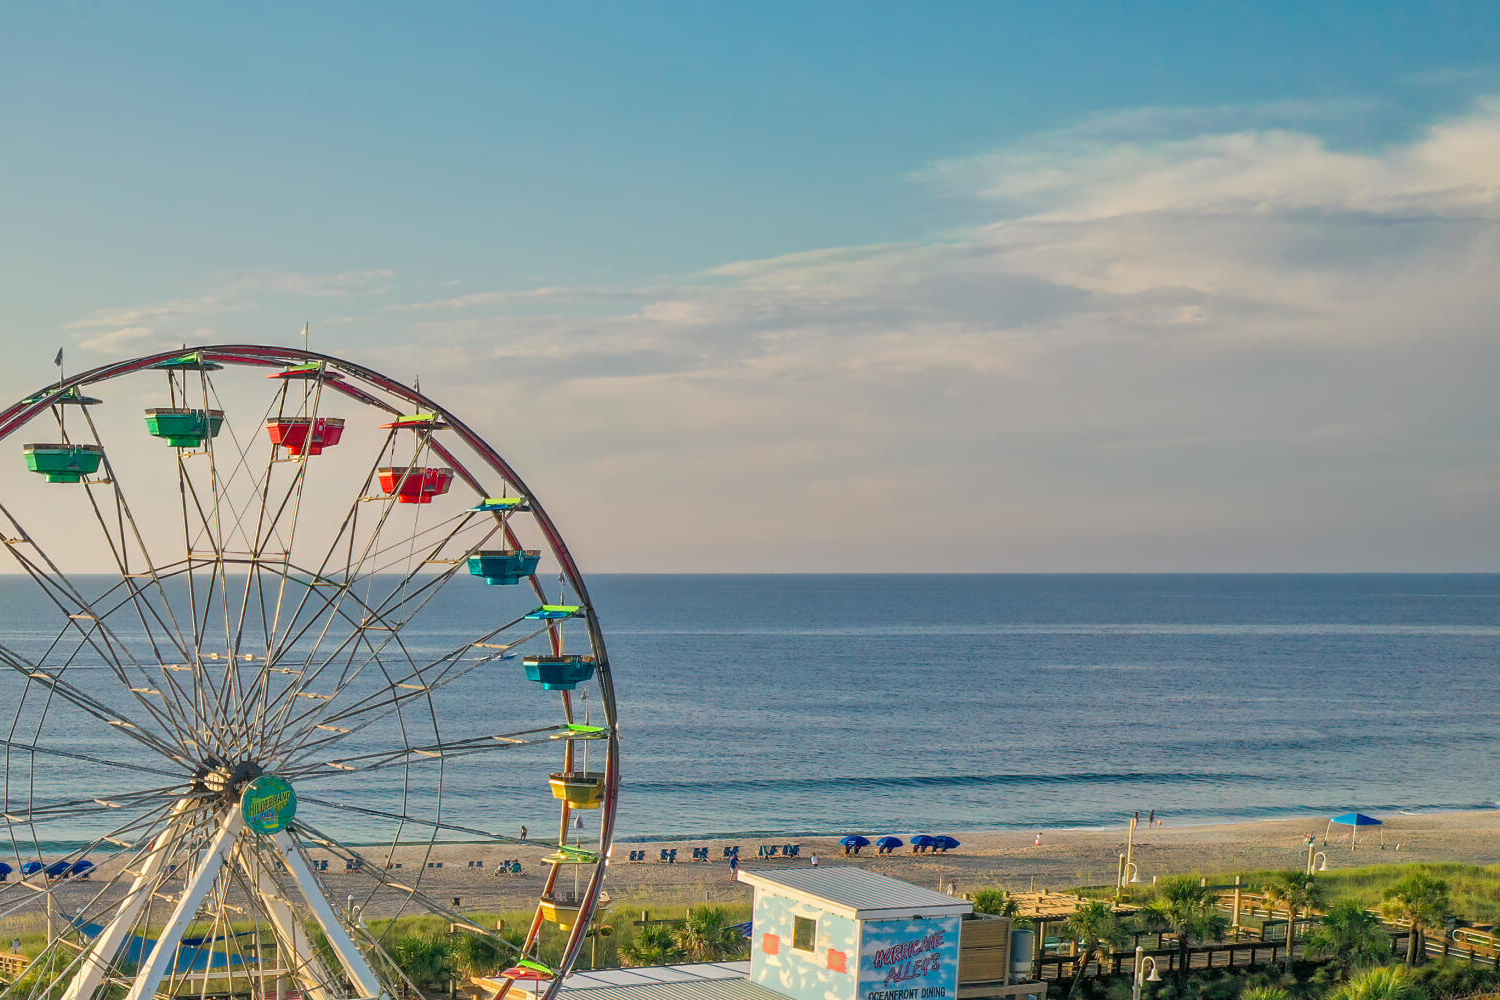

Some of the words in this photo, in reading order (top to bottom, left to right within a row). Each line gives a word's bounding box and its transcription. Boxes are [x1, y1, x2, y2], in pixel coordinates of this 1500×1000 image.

[873, 930, 946, 969] HURRICANE
[883, 952, 941, 987] ALLEY'S
[921, 986, 946, 999] DINING
